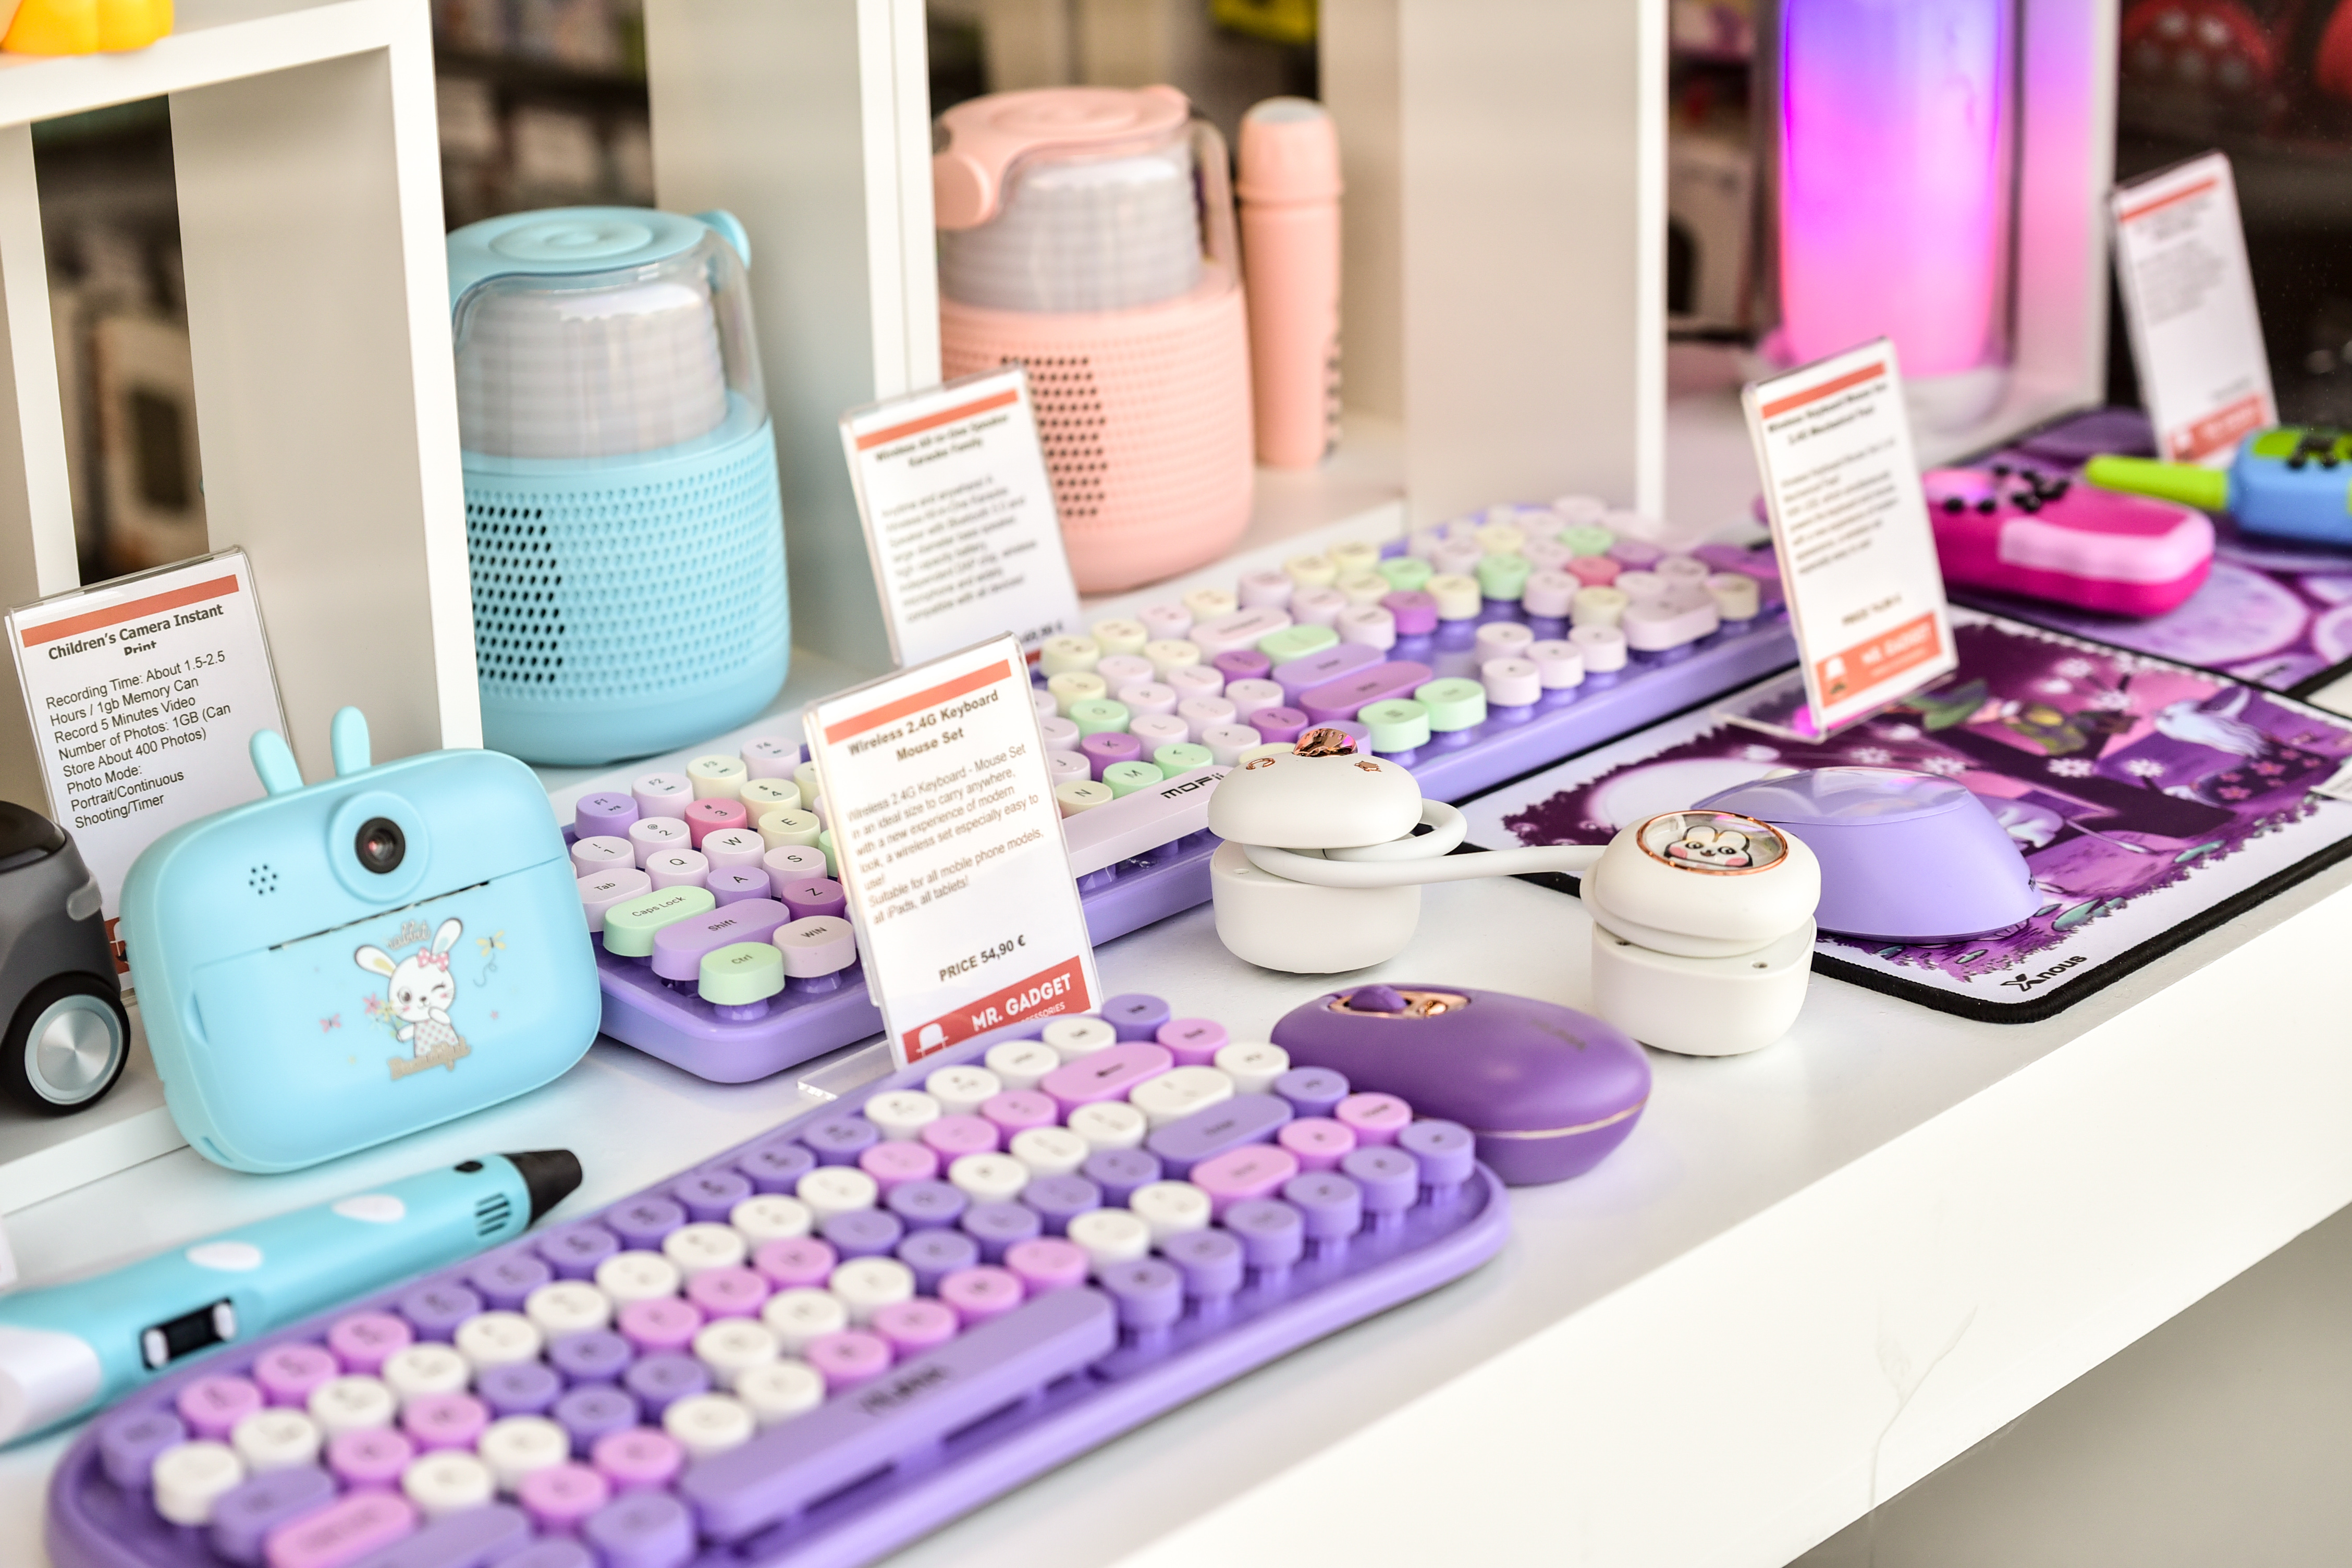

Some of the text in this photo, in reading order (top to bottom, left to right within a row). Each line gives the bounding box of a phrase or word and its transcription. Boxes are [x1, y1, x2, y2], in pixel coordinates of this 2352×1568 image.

[119, 620, 170, 641] Camera
[173, 604, 224, 627] Instant
[46, 651, 225, 709] Recording Time: About 1.5-2.5
[50, 709, 87, 726] Hours
[97, 698, 119, 714] 1gb
[122, 685, 170, 706] Memory
[174, 678, 199, 692] Can
[54, 697, 195, 743] Record 5 Minutes Video
[58, 705, 230, 761] Number of Photos: 1GB (Can
[848, 689, 999, 756] Wireless 2.4G Keyboard
[63, 728, 206, 777] Store About 400 Photos)
[896, 727, 964, 762] Mouse Set
[1102, 740, 1119, 749] K
[67, 766, 142, 794] Photo Mode:
[1124, 769, 1143, 778] M
[71, 772, 184, 812] Portrait/Continuous
[1074, 789, 1092, 797] N
[75, 795, 164, 828] Shooting/Timer
[722, 837, 742, 846] W
[594, 883, 616, 892] Tab
[805, 888, 823, 896] Z
[632, 896, 687, 917] Caps Lock
[708, 919, 738, 932] Shift
[801, 927, 827, 938] WIN
[731, 954, 753, 964] Ctrl
[938, 934, 1026, 982] PRICE 54,90 €
[972, 973, 1071, 1032] MR. GADGET
